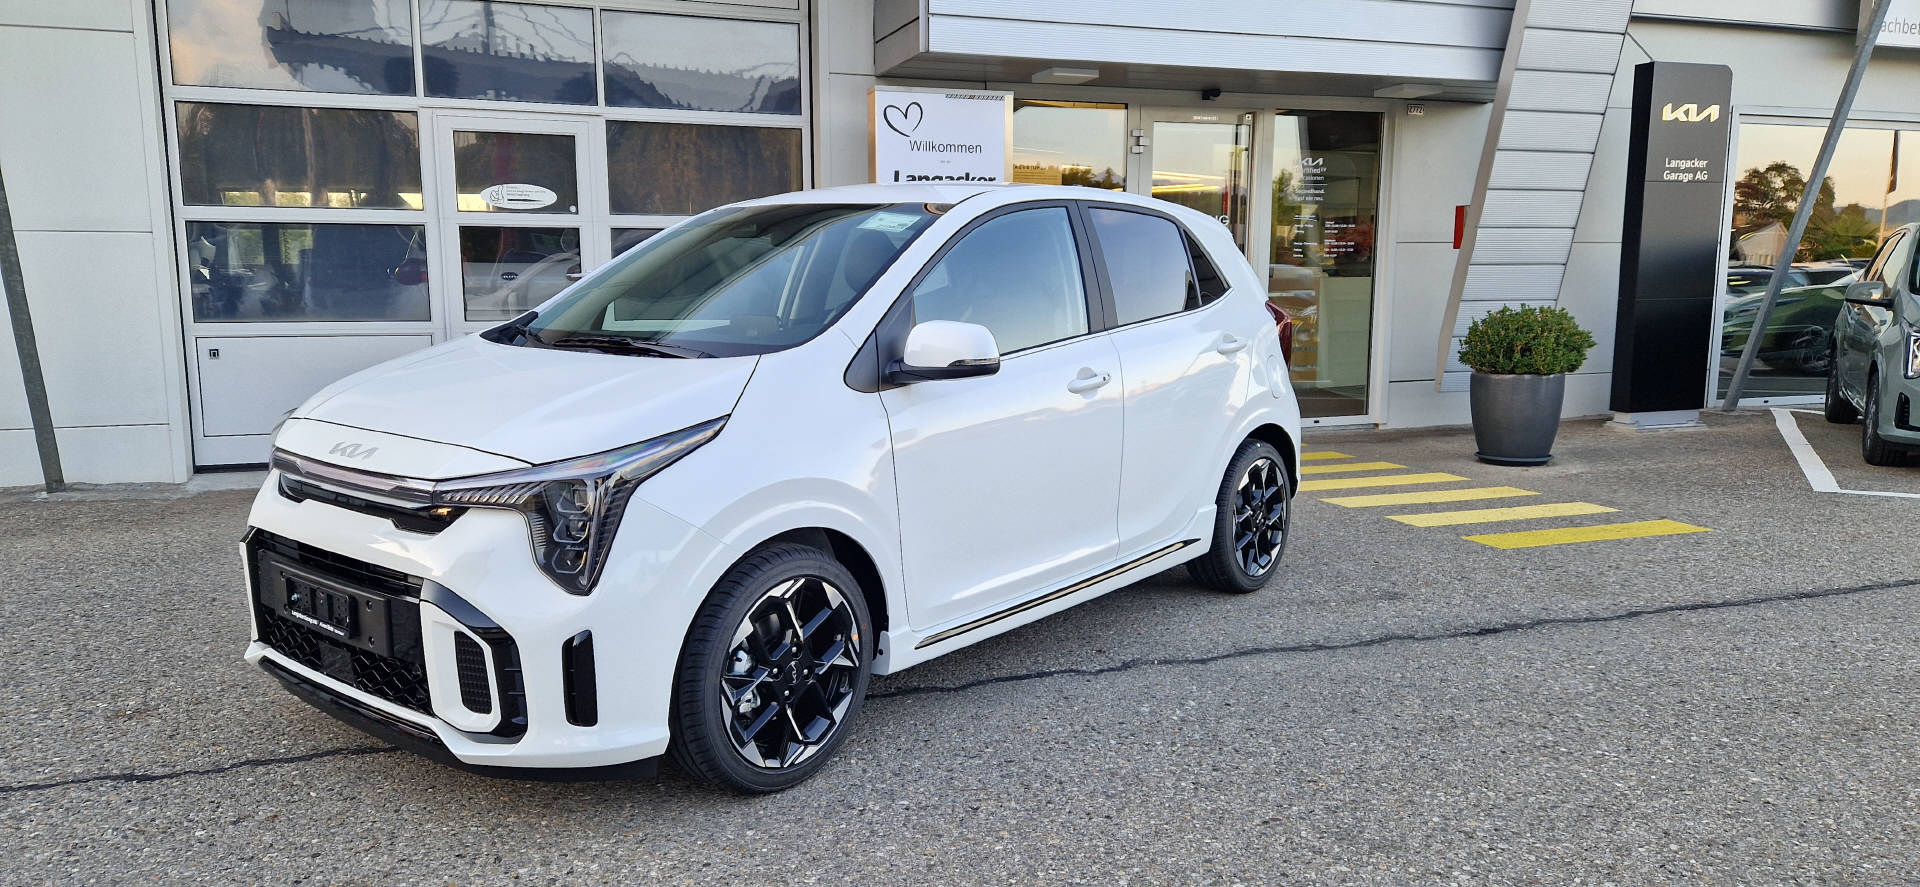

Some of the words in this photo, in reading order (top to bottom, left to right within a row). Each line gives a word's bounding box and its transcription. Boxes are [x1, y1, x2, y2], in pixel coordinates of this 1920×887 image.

[1880, 17, 1920, 35] achbe
[1662, 102, 1720, 122] KIA
[909, 140, 982, 154] Willkommen
[1665, 157, 1708, 170] Langacker
[1663, 170, 1693, 182] Garage
[1694, 171, 1708, 181] AG
